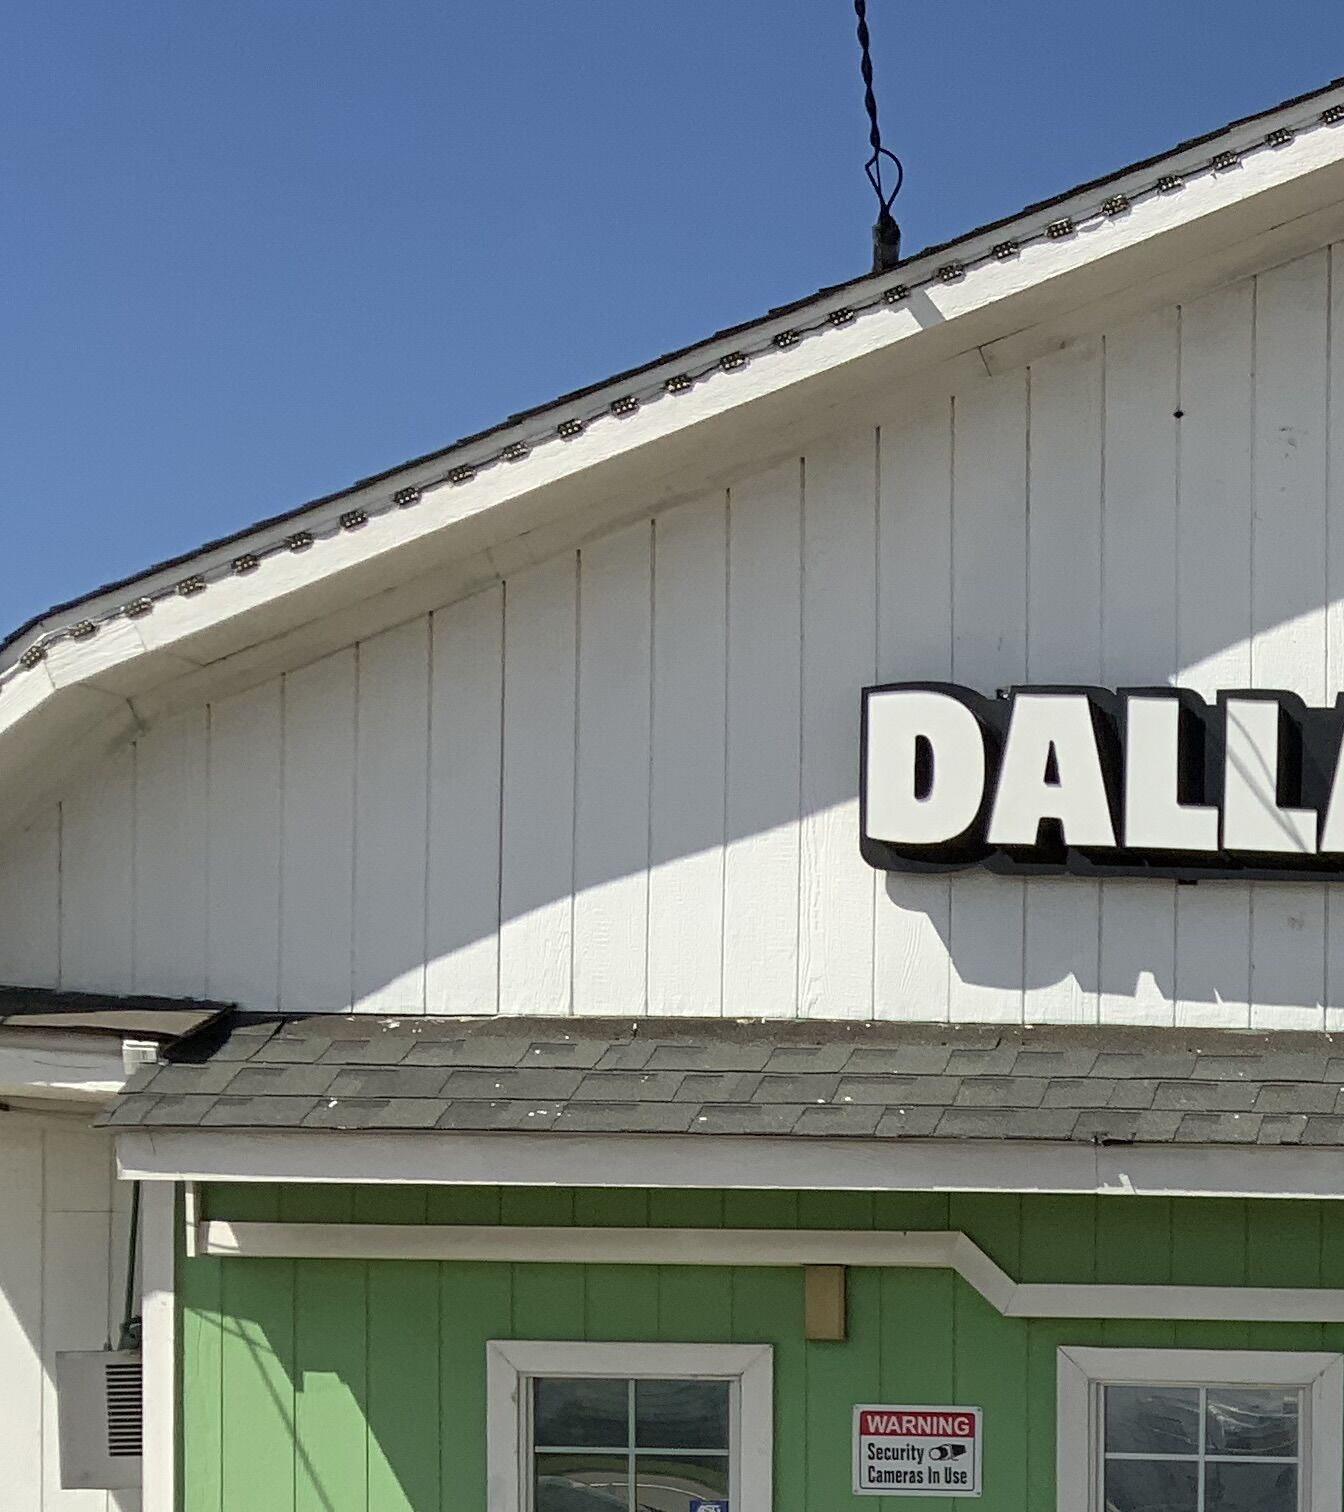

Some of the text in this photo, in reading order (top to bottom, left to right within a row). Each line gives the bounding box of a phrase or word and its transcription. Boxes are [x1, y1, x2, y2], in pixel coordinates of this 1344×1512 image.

[866, 1414, 970, 1435] WARNING
[867, 1442, 924, 1464] Security
[867, 1465, 967, 1484] Cameras In Use
